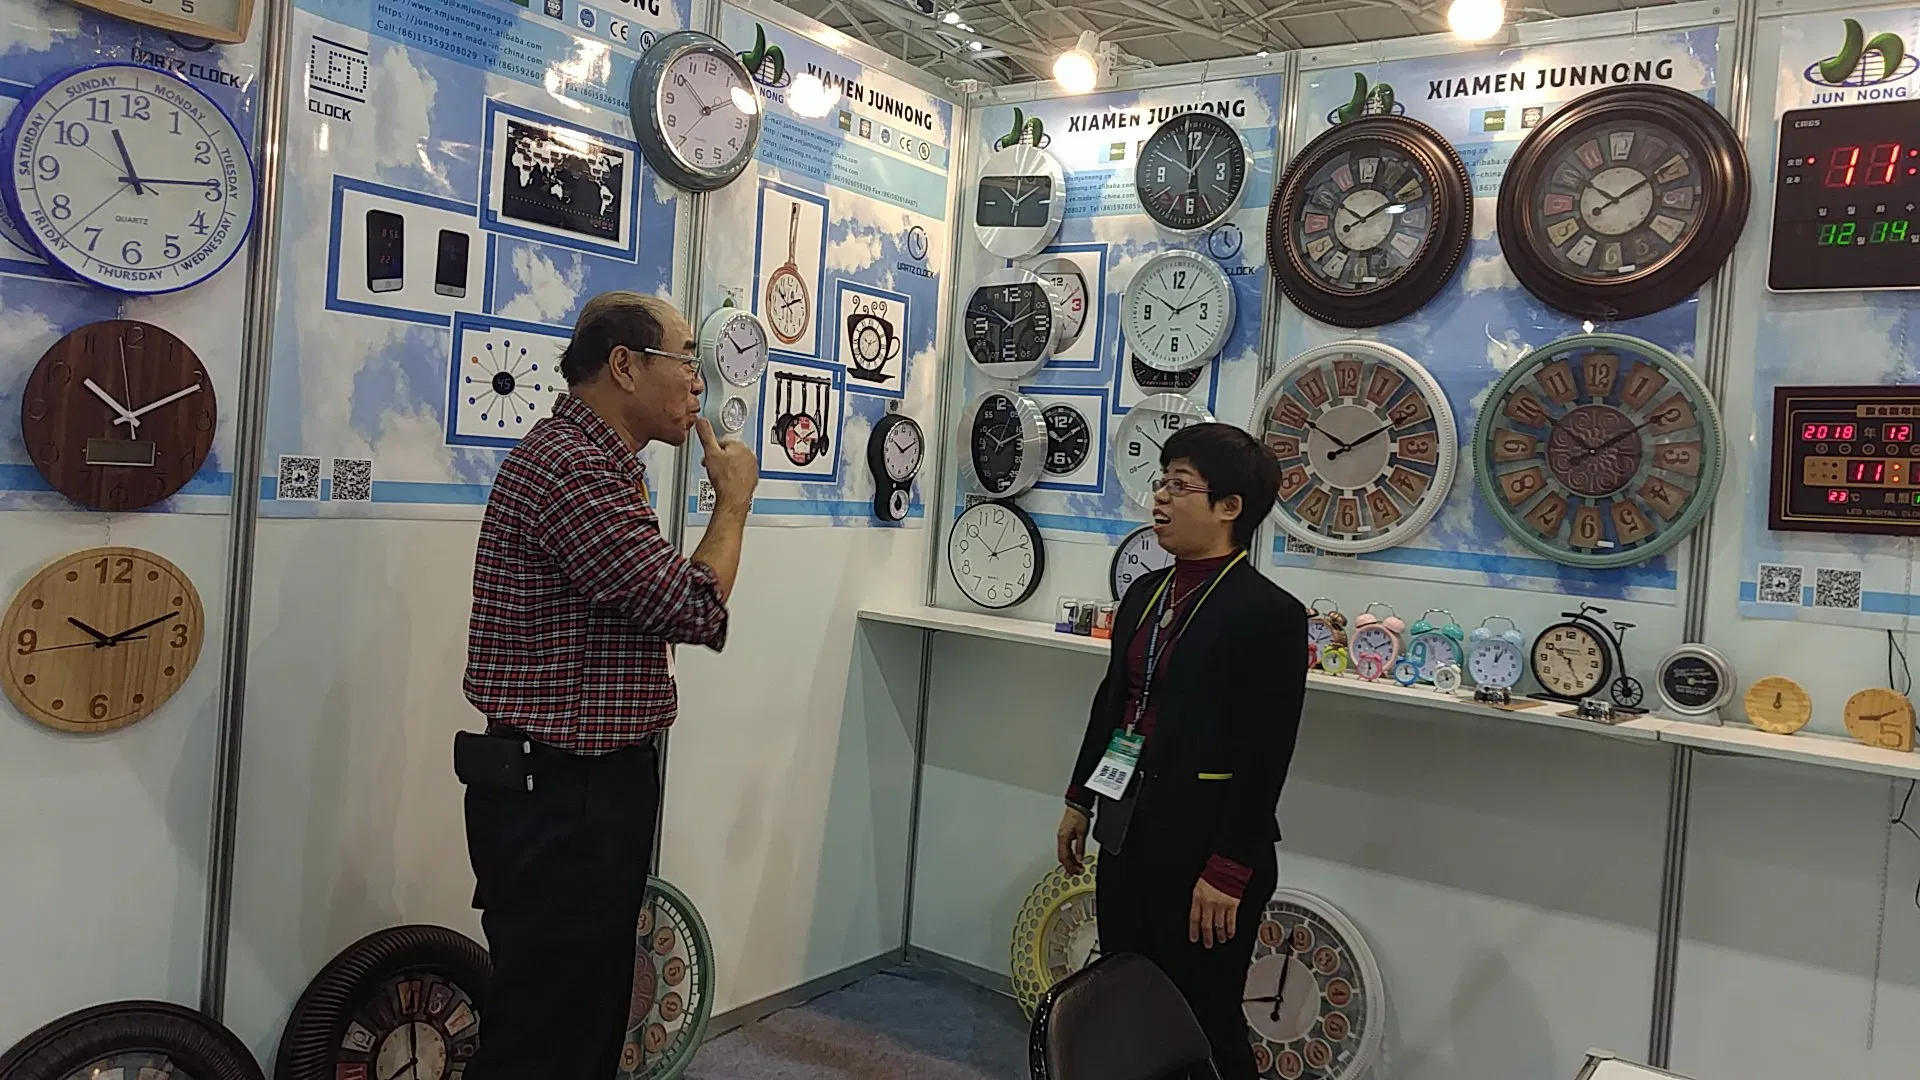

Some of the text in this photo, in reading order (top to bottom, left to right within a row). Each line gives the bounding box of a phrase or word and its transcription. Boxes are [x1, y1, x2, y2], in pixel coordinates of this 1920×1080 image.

[189, 63, 240, 88] CLOCK
[689, 62, 697, 74] 11
[704, 61, 718, 75] 12
[1427, 59, 1673, 100] XIAMEN JUNNONG
[65, 76, 117, 98] SUNDAY
[665, 92, 675, 104] 9
[1812, 86, 1907, 104] JUN NONG
[86, 98, 112, 124] 11
[120, 95, 150, 121] 12
[154, 84, 207, 121] MONDAY
[308, 99, 352, 122] CLOCK
[868, 90, 932, 130] JUNNONG
[169, 111, 182, 135] 1
[667, 115, 677, 127] 8
[1068, 113, 1140, 132] XIAMEN
[20, 113, 46, 176] SATURDAY
[54, 120, 89, 147] 10
[1188, 132, 1202, 150] 12
[194, 141, 212, 165] 2
[694, 148, 704, 161] 6
[713, 147, 722, 160] 5
[38, 155, 60, 181] 9
[221, 147, 238, 200] TUESDAY
[1157, 167, 1165, 182] 9
[1216, 163, 1225, 180] 3
[204, 178, 222, 202] 3
[51, 194, 71, 220] 8
[1186, 198, 1194, 214] 6
[31, 209, 69, 252] FRIDAY
[115, 215, 149, 225] QUARTZ
[188, 210, 210, 235] 4
[84, 226, 104, 251] 7
[181, 218, 233, 271] WEDNESDAY
[1827, 223, 1856, 245] 12
[122, 241, 143, 265] 6
[163, 235, 181, 259] 5
[97, 265, 163, 282] THURSDAY
[1172, 272, 1186, 289] 12
[1144, 305, 1151, 320] 9
[1200, 303, 1208, 320] 3
[1171, 337, 1178, 352] 6
[1339, 367, 1358, 390] 12
[1589, 362, 1611, 387] 12
[1054, 416, 1067, 428] 12
[1161, 415, 1180, 429] 12
[1804, 426, 1853, 439] 2018
[1889, 426, 1909, 440] 12
[1129, 442, 1141, 457] 9
[1829, 492, 1847, 502] 23
[1141, 540, 1149, 550] 11
[94, 557, 135, 584] 12
[1128, 554, 1138, 565] 10
[17, 629, 37, 656] 9
[170, 624, 188, 649] 3
[89, 694, 108, 719] 6
[1879, 722, 1902, 749] 5
